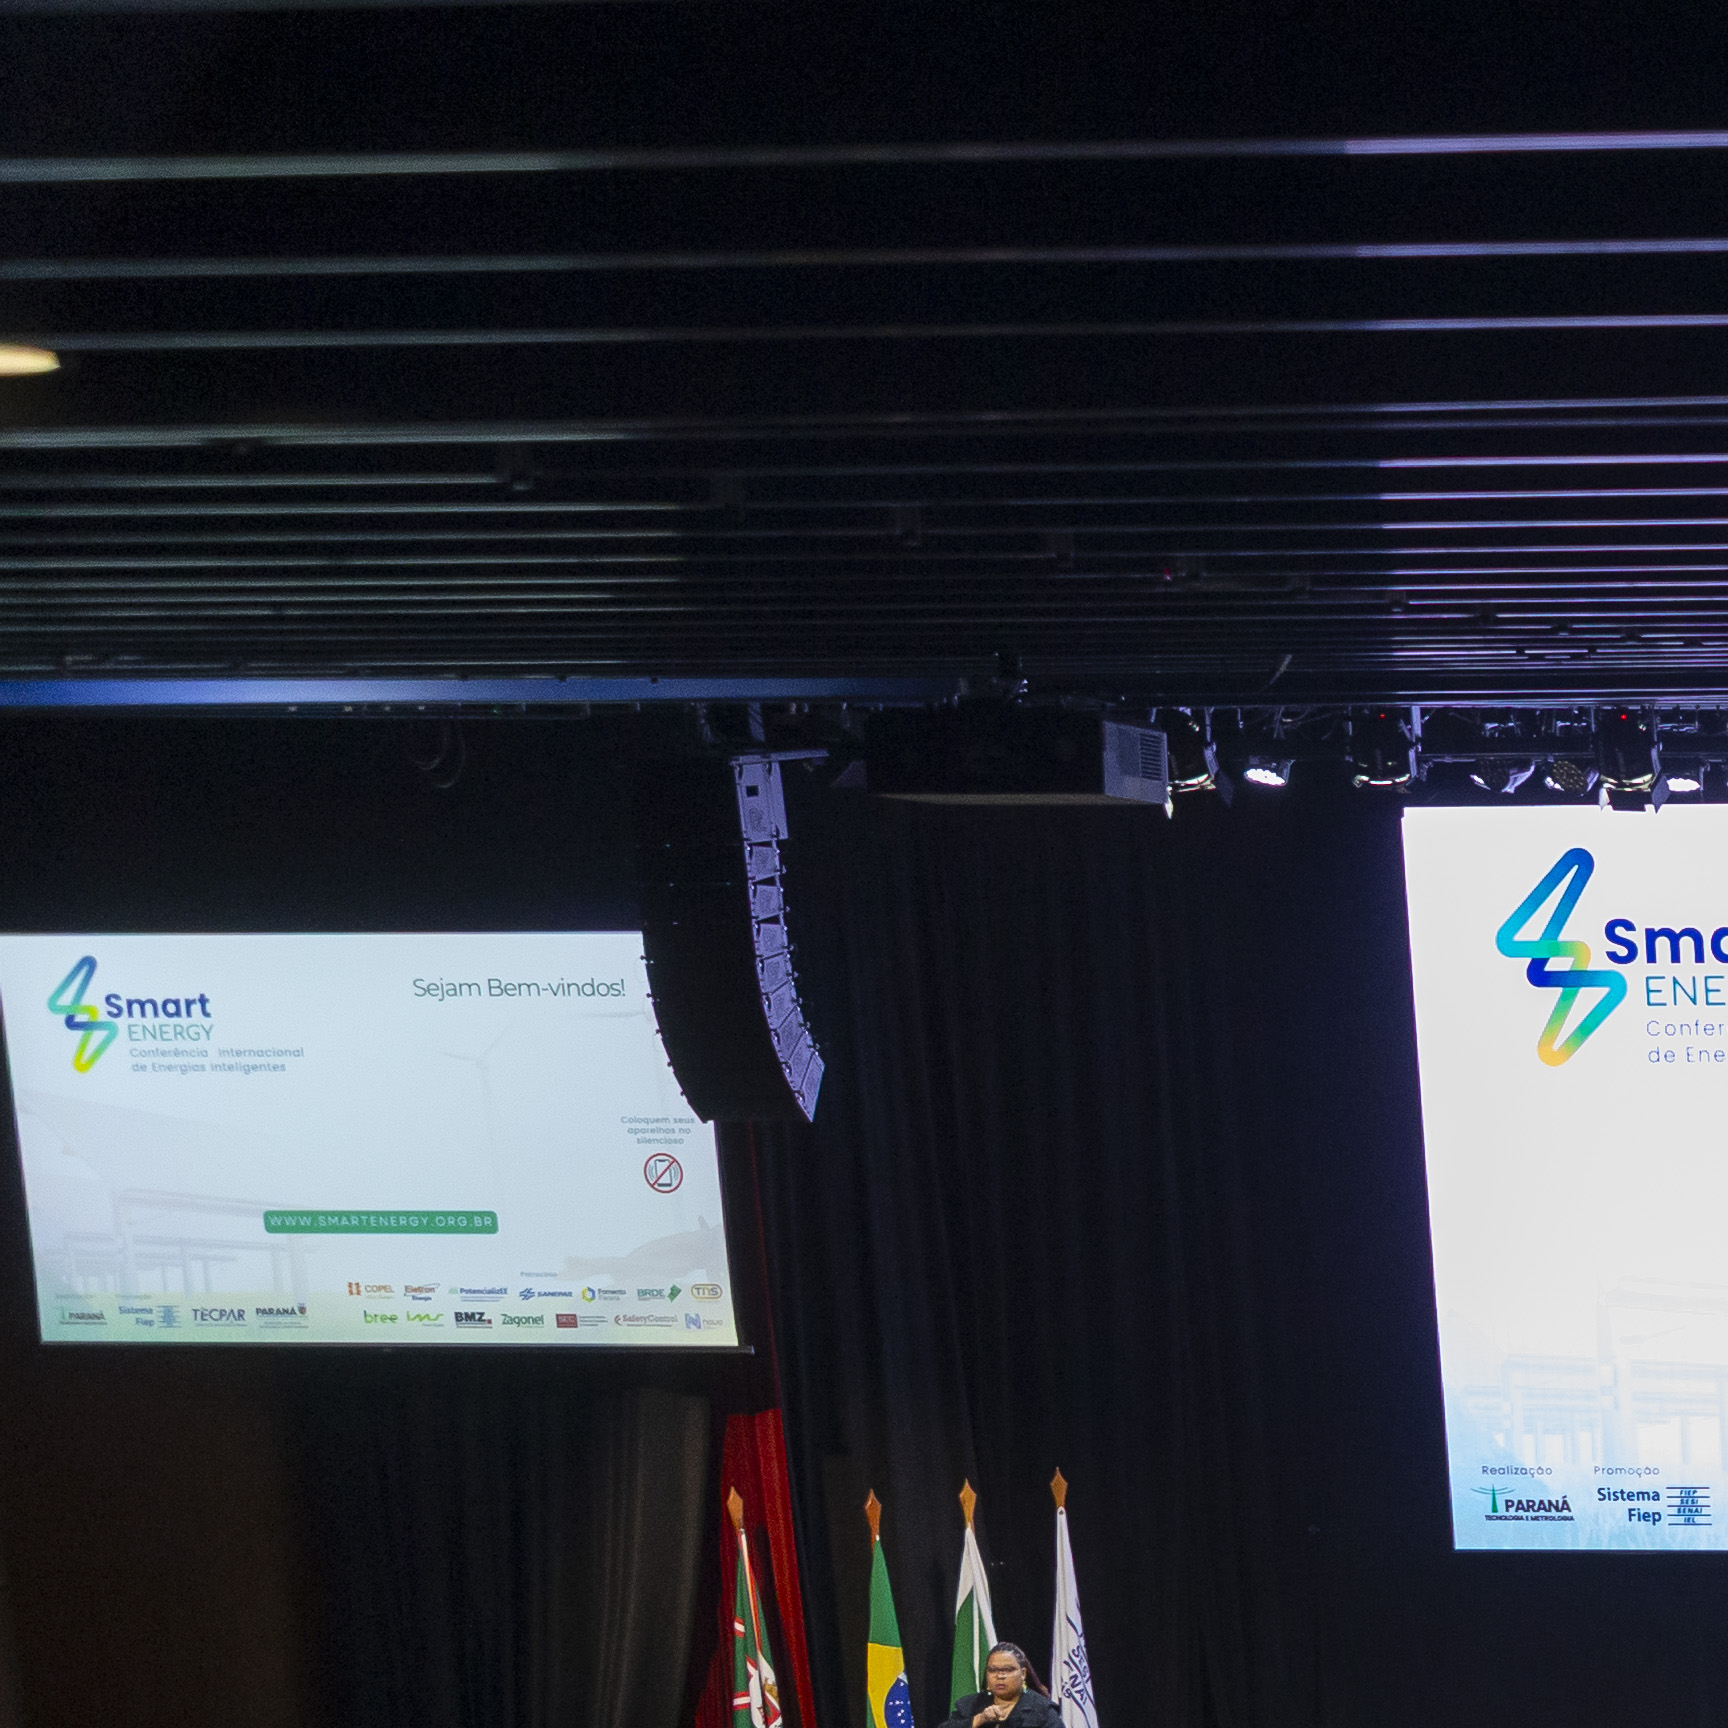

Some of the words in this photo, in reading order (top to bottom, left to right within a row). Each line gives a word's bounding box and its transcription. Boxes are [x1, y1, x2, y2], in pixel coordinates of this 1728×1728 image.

[412, 977, 482, 1001] Sejam
[487, 977, 626, 998] Bem-vindos!
[104, 993, 212, 1019] Smart
[127, 1023, 214, 1042] ENERGY
[218, 1046, 305, 1058] Internacional
[1648, 1045, 1675, 1064] de
[131, 1061, 147, 1073] de
[151, 1061, 206, 1075] Energias
[211, 1061, 287, 1075] Inteligentes
[620, 1115, 671, 1125] Coloquem
[267, 1215, 493, 1228] WWW.SMARTENERGY.ORG.BR
[637, 1287, 666, 1298] BRDE
[363, 1310, 399, 1325] bree
[501, 1313, 545, 1328] Zagonel
[1481, 1465, 1553, 1479] Realização
[1593, 1465, 1660, 1478] Promoção
[1596, 1487, 1661, 1501] Sistema
[1504, 1494, 1572, 1513] PARANÁ
[1627, 1508, 1662, 1526] Fiep
